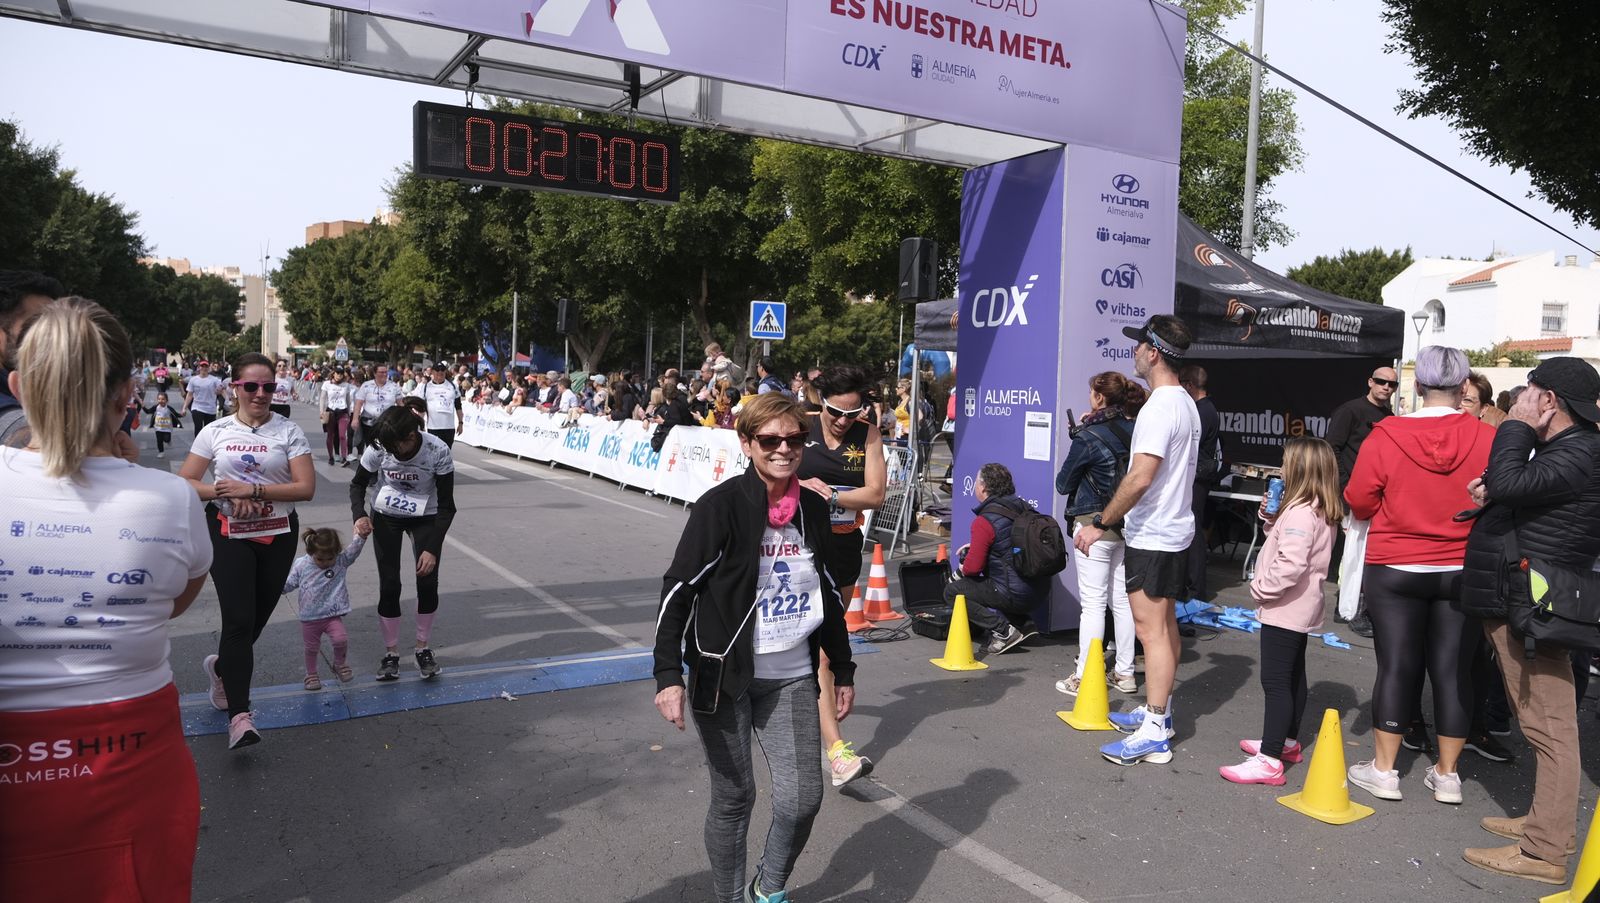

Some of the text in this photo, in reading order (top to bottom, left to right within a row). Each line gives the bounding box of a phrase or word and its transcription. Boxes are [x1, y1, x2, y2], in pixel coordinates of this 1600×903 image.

[872, 0, 995, 52] NUESTRA
[999, 29, 1072, 70] META.
[842, 43, 887, 71] CDX
[931, 59, 977, 80] ALMERÍA
[931, 72, 956, 85] CIUDAD
[465, 116, 669, 193] 00:27:00
[1100, 193, 1150, 210] HYUNDAI
[1111, 231, 1151, 246] cajamar
[1101, 267, 1136, 289] CASI
[971, 275, 1039, 329] CDX
[1110, 302, 1146, 318] vithas
[984, 386, 1042, 406] ALMERÍA
[983, 405, 1012, 417] CIUDAD
[225, 445, 269, 453] MUJER
[387, 471, 420, 481] MUJER
[384, 494, 418, 513] 1223
[36, 522, 93, 535] ALMERÍA
[47, 567, 96, 577] cajamar
[106, 571, 147, 585] CASI
[26, 596, 65, 604] aqualia
[757, 592, 812, 618] 1222
[762, 615, 779, 624] MARI
[779, 612, 807, 623] MARTINEZ
[68, 643, 113, 651] ALMERÍA
